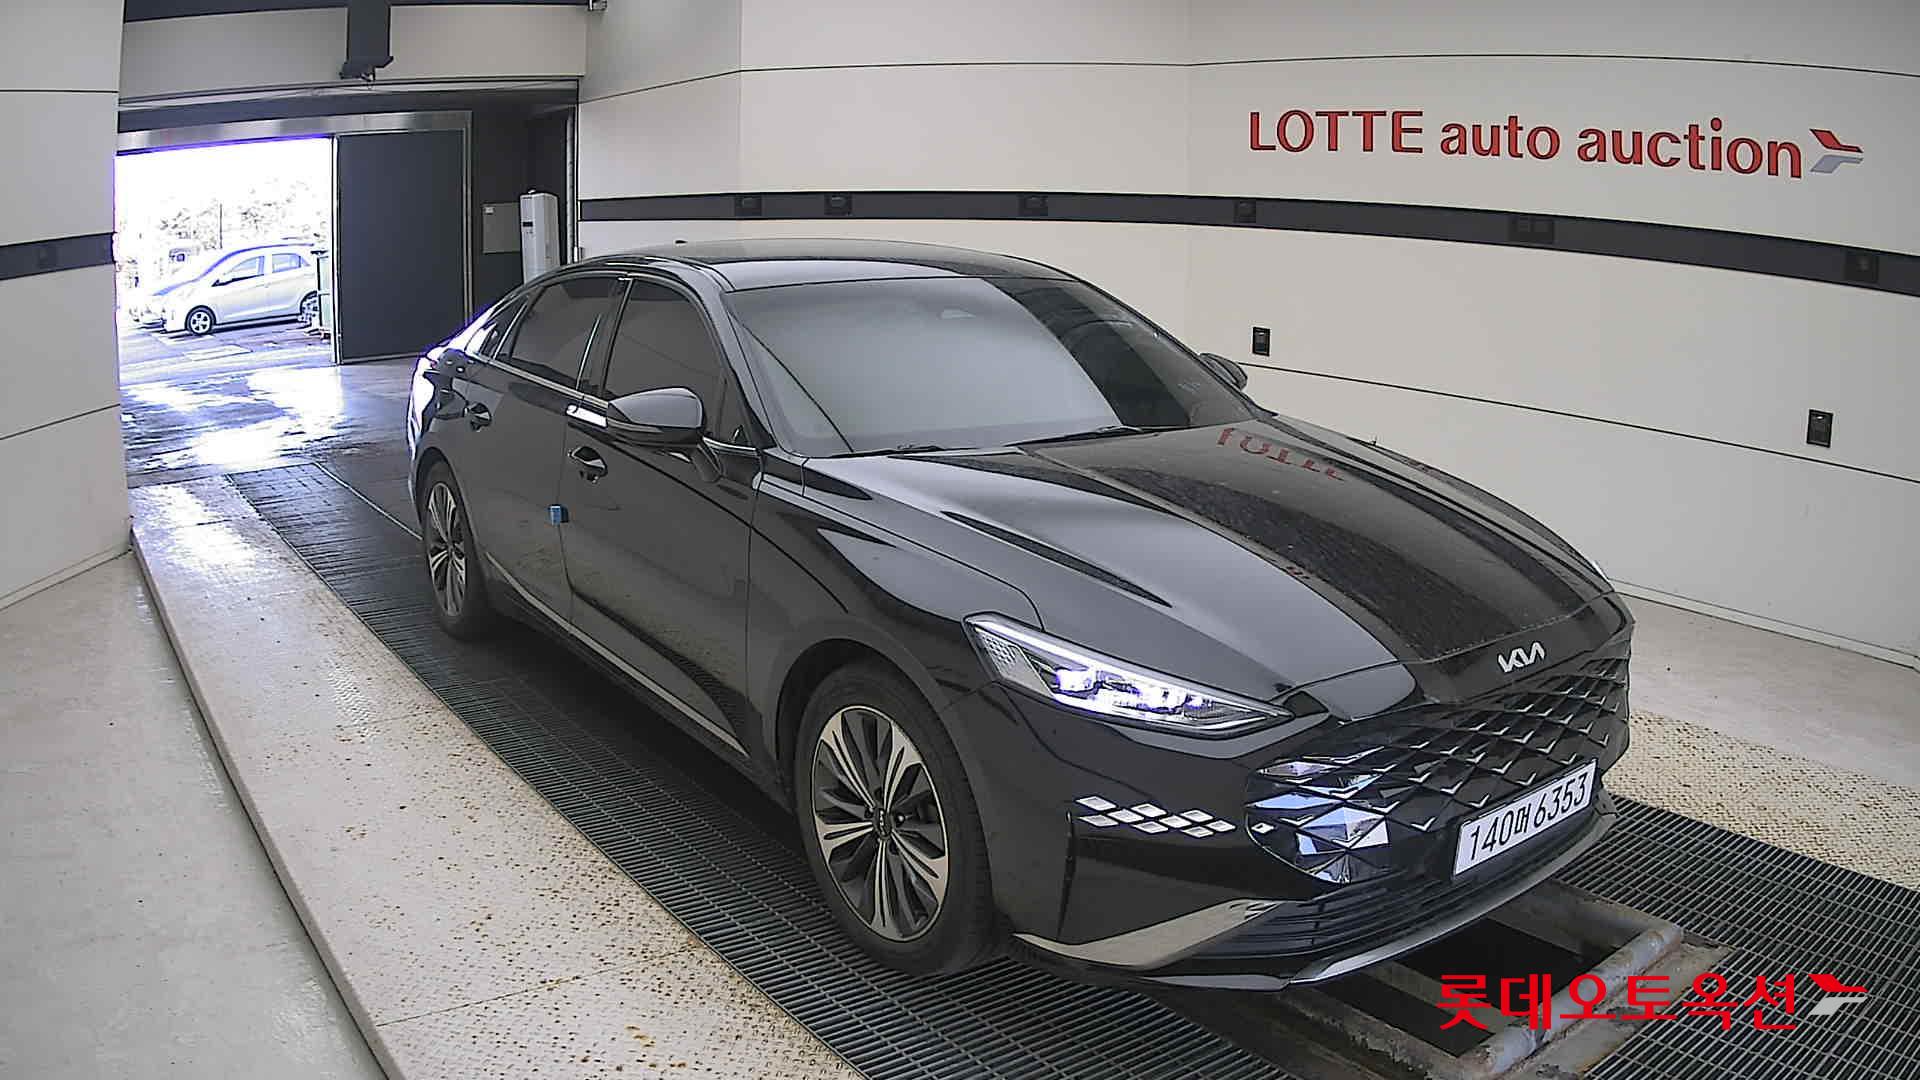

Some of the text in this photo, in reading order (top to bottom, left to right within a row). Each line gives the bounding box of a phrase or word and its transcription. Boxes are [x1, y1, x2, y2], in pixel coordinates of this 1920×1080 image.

[1249, 110, 1802, 179] LOTTE auto auction
